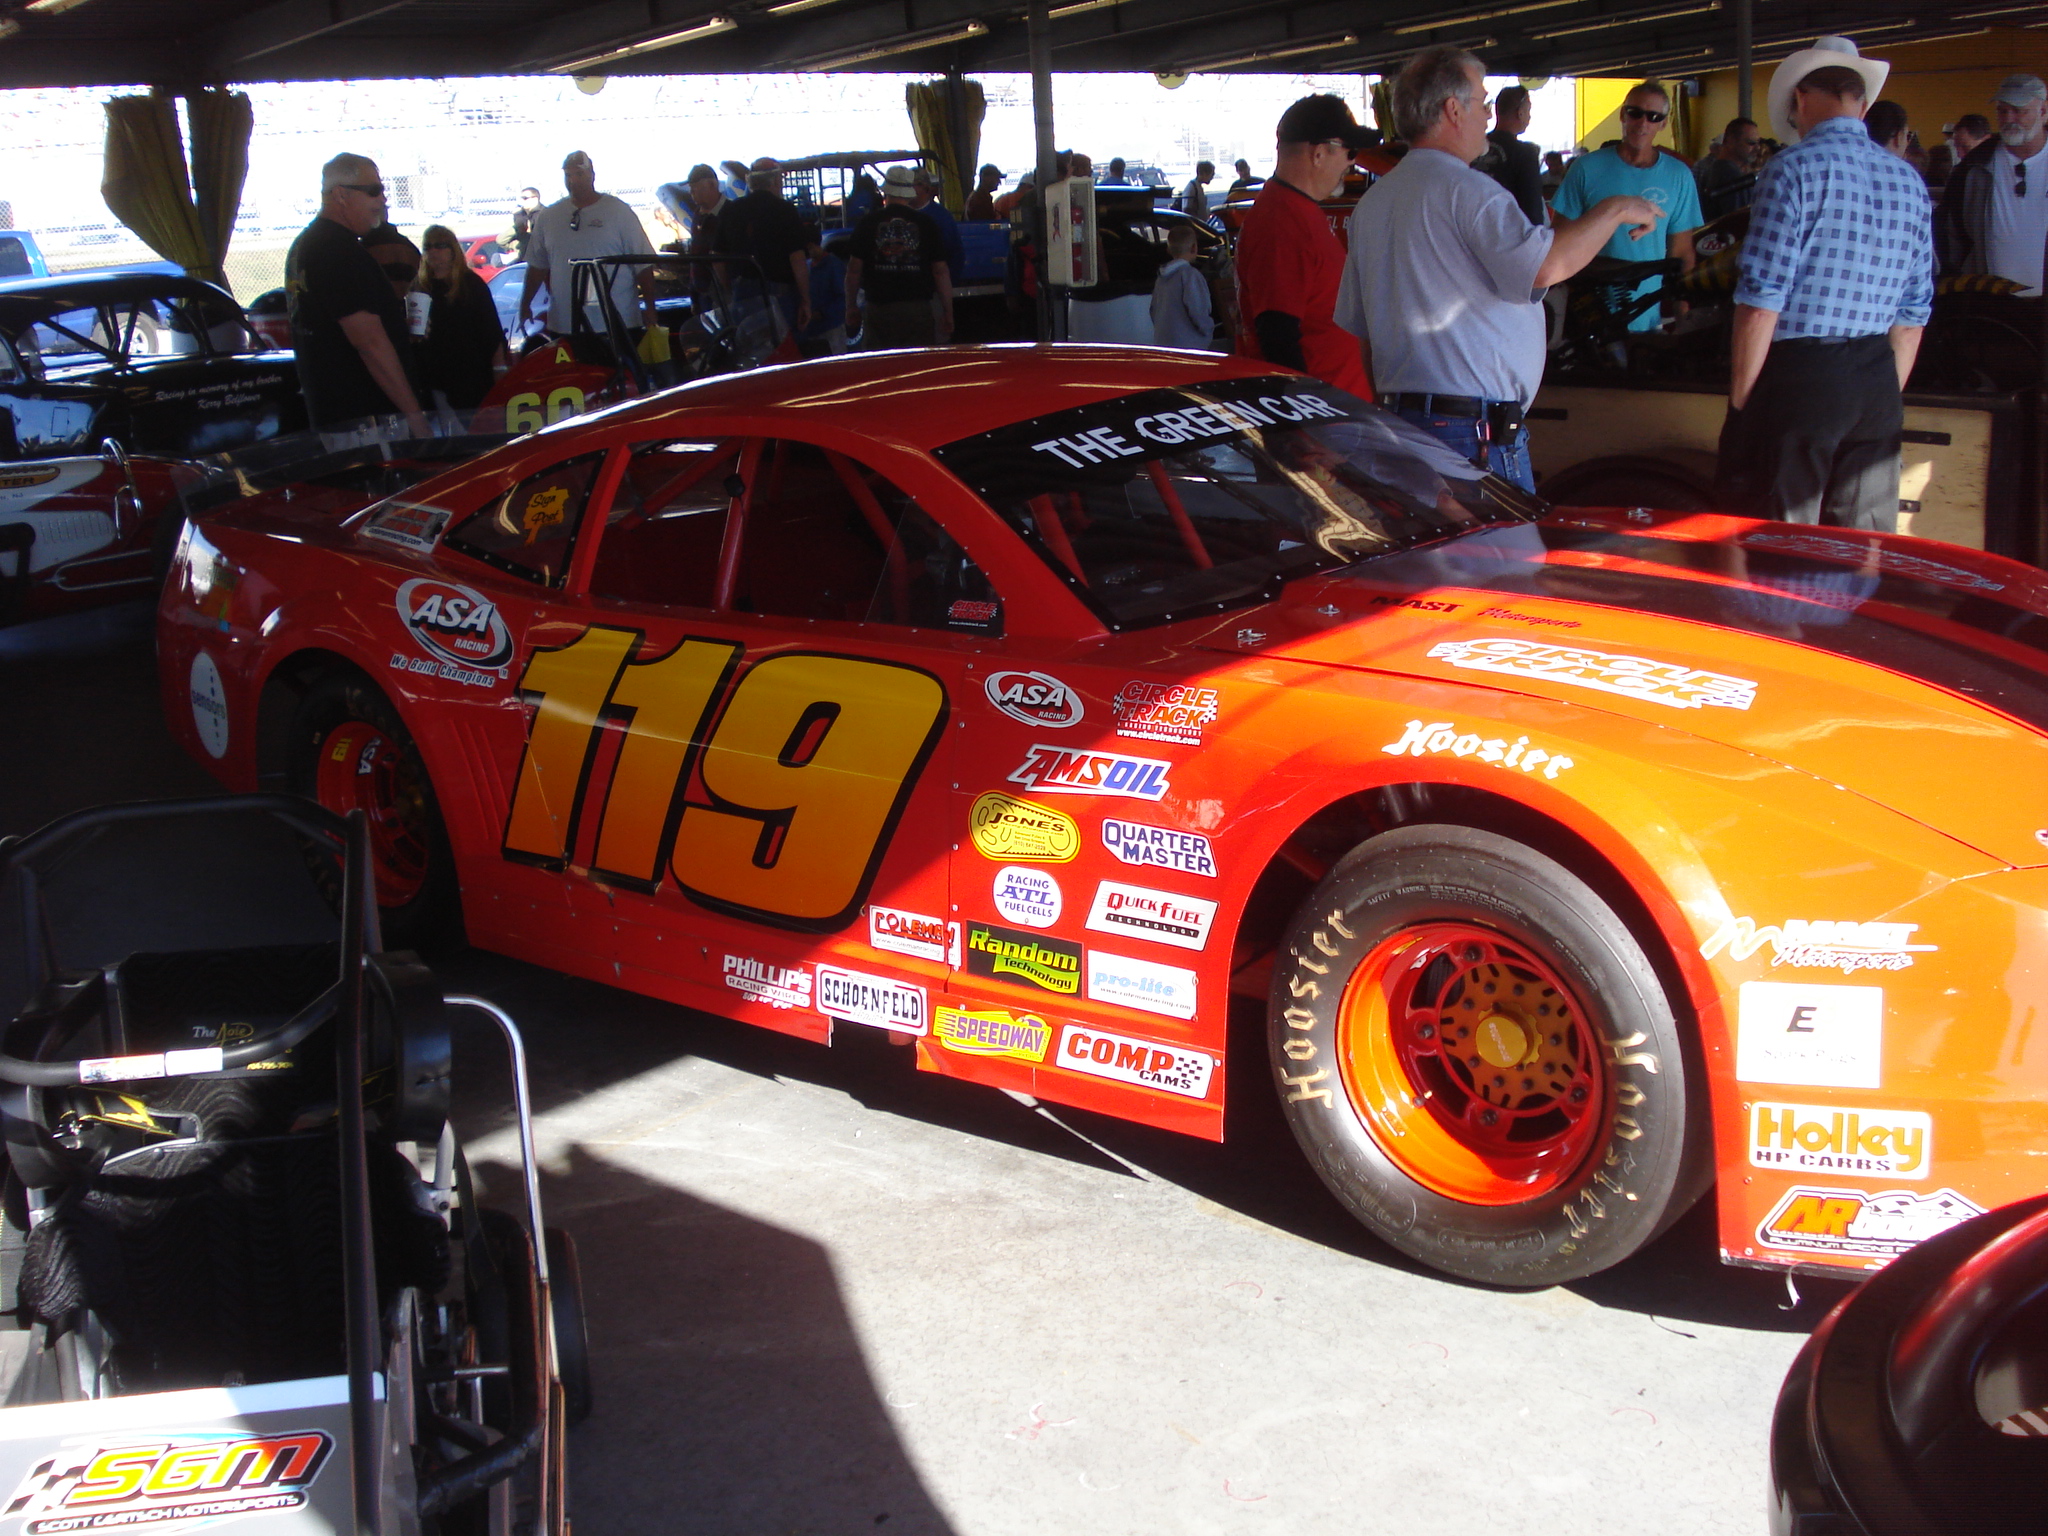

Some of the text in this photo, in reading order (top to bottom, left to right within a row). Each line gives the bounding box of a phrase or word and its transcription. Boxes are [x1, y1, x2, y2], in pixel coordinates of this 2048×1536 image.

[555, 346, 572, 364] A
[154, 374, 283, 401] Racing in memory of my brother
[506, 386, 585, 434] 60
[1031, 393, 1350, 470] THE GREEN CAR
[410, 593, 496, 640] ASA
[949, 609, 993, 621] TRACK
[951, 599, 999, 613] CIRCLE
[1370, 594, 1465, 615] MAST
[1476, 606, 1582, 630] Motorsports
[453, 637, 491, 654] RACING
[390, 653, 496, 688] We Build Champions
[1463, 638, 1760, 690] CIRCLE
[1000, 683, 1067, 709] ASA
[1122, 680, 1218, 709] CIRCLE
[1452, 652, 1707, 709] TRACK
[1037, 710, 1067, 721] RACING
[1118, 702, 1204, 730] TRACK
[1381, 719, 1575, 781] Hoosier
[501, 621, 951, 936] 119
[1009, 747, 1169, 797] AMSOIL
[989, 812, 1068, 833] JONES
[1104, 821, 1207, 856] QUARTER
[1123, 841, 1212, 875] MASTER
[996, 884, 1055, 907] ATL
[1007, 873, 1050, 890] RACING
[1107, 892, 1206, 926] QUICK FUEL
[1107, 914, 1199, 937] TECHNOLOGY
[968, 928, 1079, 972] Random
[723, 954, 813, 994] PHILLIP'S
[728, 976, 768, 994] RACING
[1002, 955, 1072, 991] Technology
[1092, 970, 1175, 998] pro-lite
[823, 977, 919, 1021] SCHOENFELD
[1280, 908, 1357, 1110] Hoosier
[191, 1025, 216, 1040] The
[1066, 1032, 1175, 1075] COMP
[1138, 1069, 1193, 1090] CAMS
[1757, 1106, 1923, 1173] Holley
[1755, 1150, 1892, 1172] HP CARBS
[1769, 1236, 1841, 1250] ALUMINUM
[67, 1433, 325, 1501] SGM
[36, 1516, 94, 1534] SCOTT
[172, 1494, 300, 1520] MOTORSPORTS
